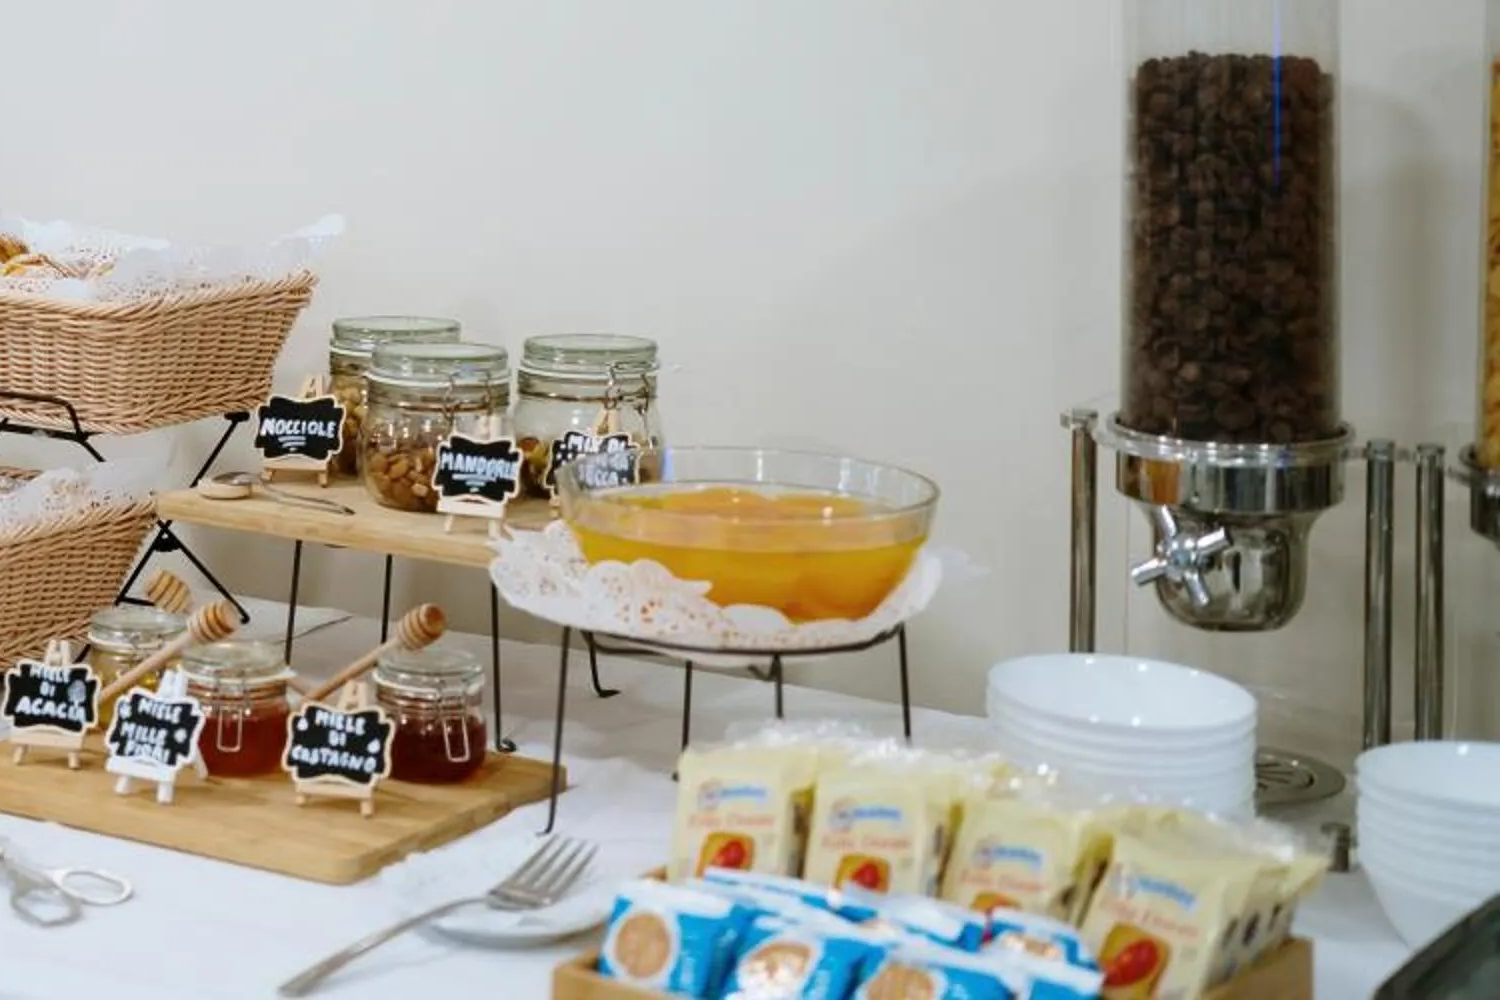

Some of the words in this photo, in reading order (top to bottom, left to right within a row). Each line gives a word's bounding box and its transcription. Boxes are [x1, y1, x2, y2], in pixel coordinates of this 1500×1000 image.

[260, 417, 337, 438] NOCCIOLE
[567, 434, 601, 454] MIX
[40, 681, 56, 697] DI
[15, 695, 86, 722] ACACIA
[138, 698, 182, 724] MIELE
[120, 721, 168, 747] MILLE
[315, 710, 366, 736] MIELE
[328, 730, 347, 747] DI
[291, 745, 377, 774] CASTAGNO
